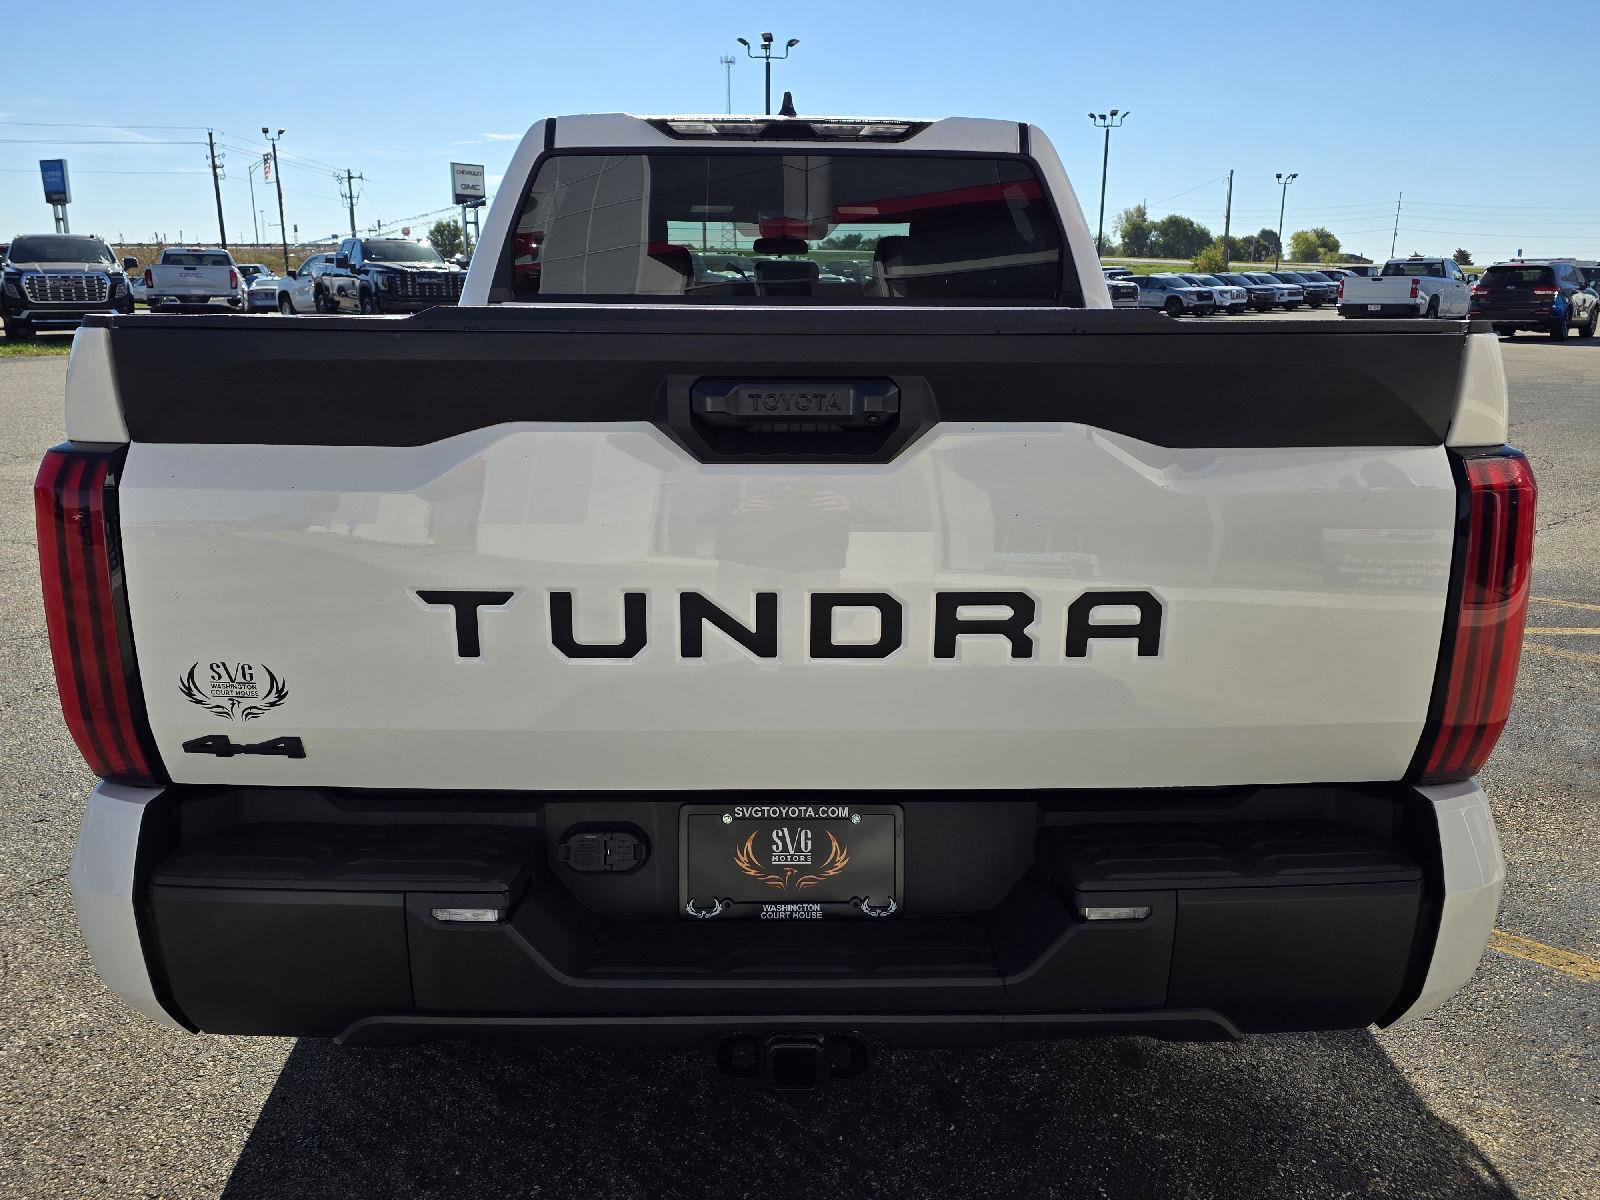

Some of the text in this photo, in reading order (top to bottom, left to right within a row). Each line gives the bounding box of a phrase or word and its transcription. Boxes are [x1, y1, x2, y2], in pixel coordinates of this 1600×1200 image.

[460, 183, 480, 191] GMC
[747, 392, 842, 412] TOYOTA
[414, 590, 1164, 659] TUNDRA
[209, 661, 254, 683] SVG
[734, 806, 849, 818] SVGTOYOTA.COM
[771, 827, 812, 855] SVG
[760, 911, 823, 919] COURT HOUSE
[762, 904, 820, 912] WASHINGTON
